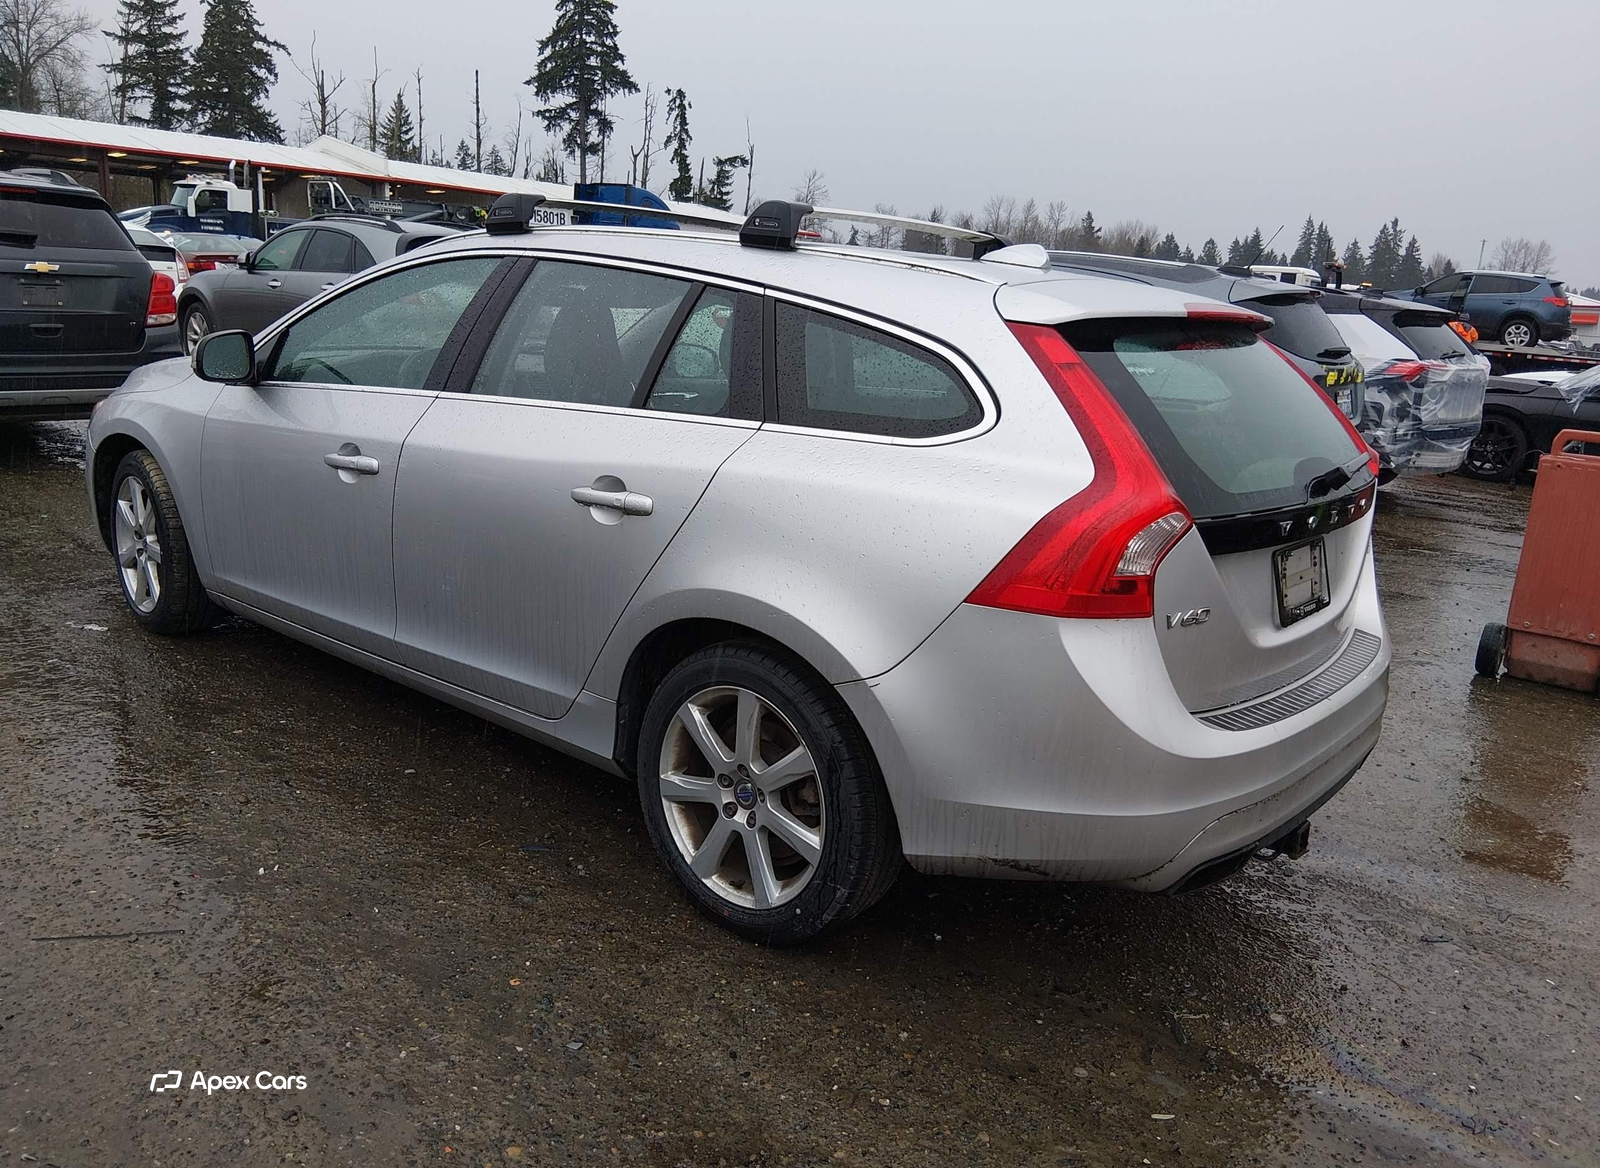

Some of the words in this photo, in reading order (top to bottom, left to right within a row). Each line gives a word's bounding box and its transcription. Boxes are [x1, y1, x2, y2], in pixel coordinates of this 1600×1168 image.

[369, 200, 403, 214] ROTATOR
[1279, 498, 1367, 537] VOLVO
[1166, 606, 1211, 630] V60
